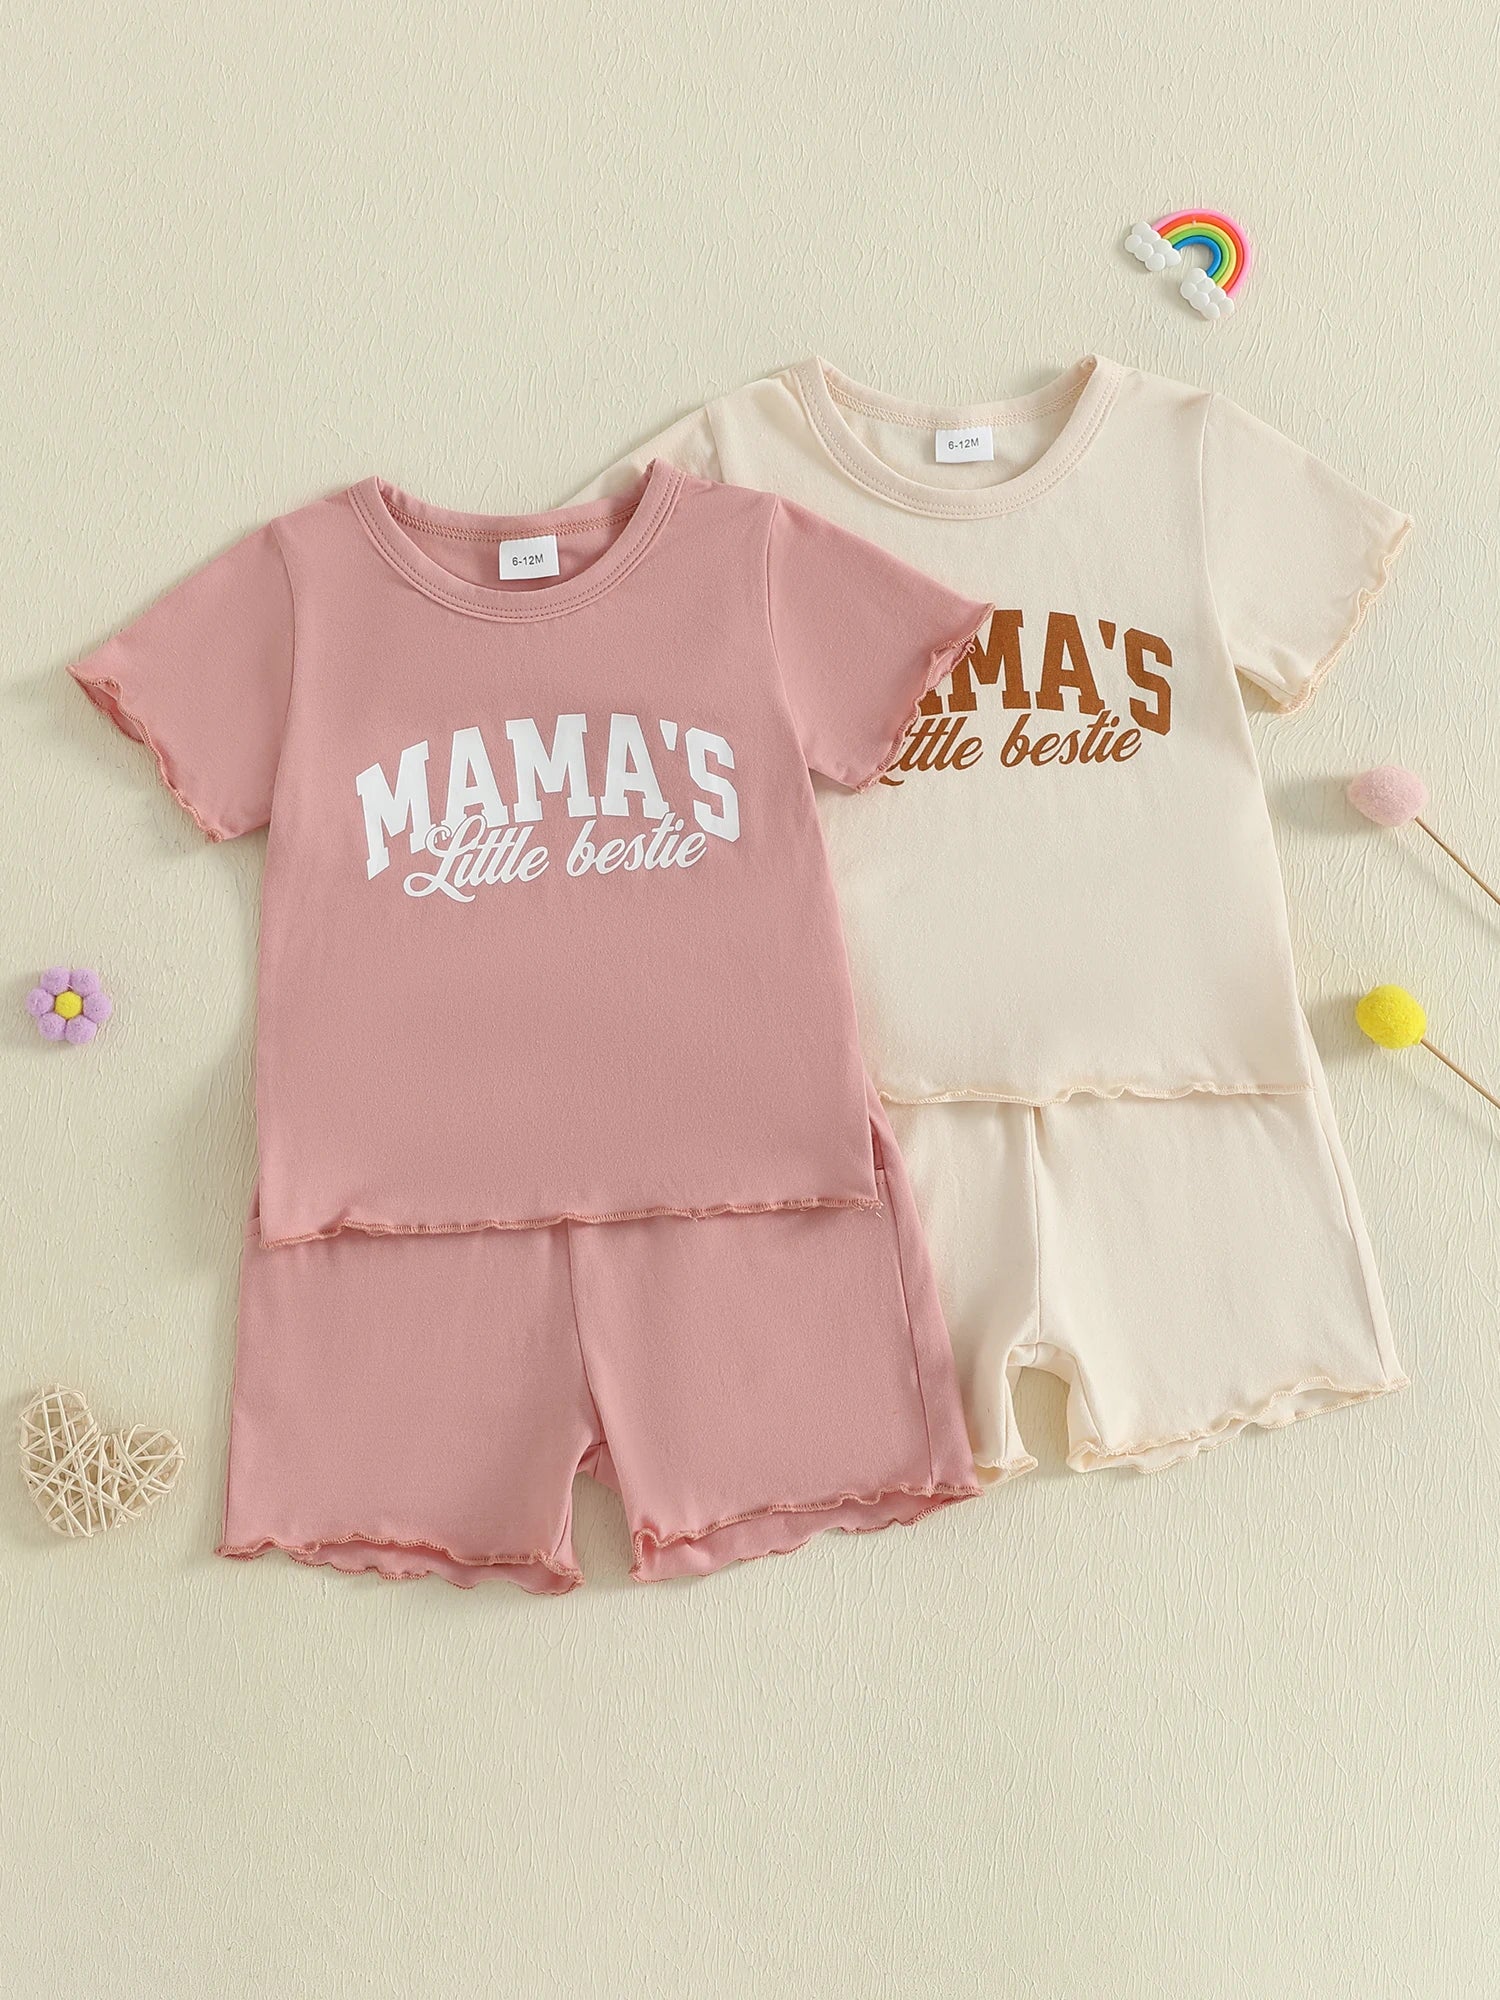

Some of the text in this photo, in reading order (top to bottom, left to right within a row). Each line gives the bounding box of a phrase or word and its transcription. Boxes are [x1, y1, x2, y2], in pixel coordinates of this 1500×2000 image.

[947, 436, 980, 451] 6-12M
[511, 552, 545, 567] 6-12M
[918, 609, 1173, 736] MA'S
[1000, 709, 1142, 767] bestie
[355, 713, 741, 881] MAMA'S
[403, 812, 707, 903] Little bestie
